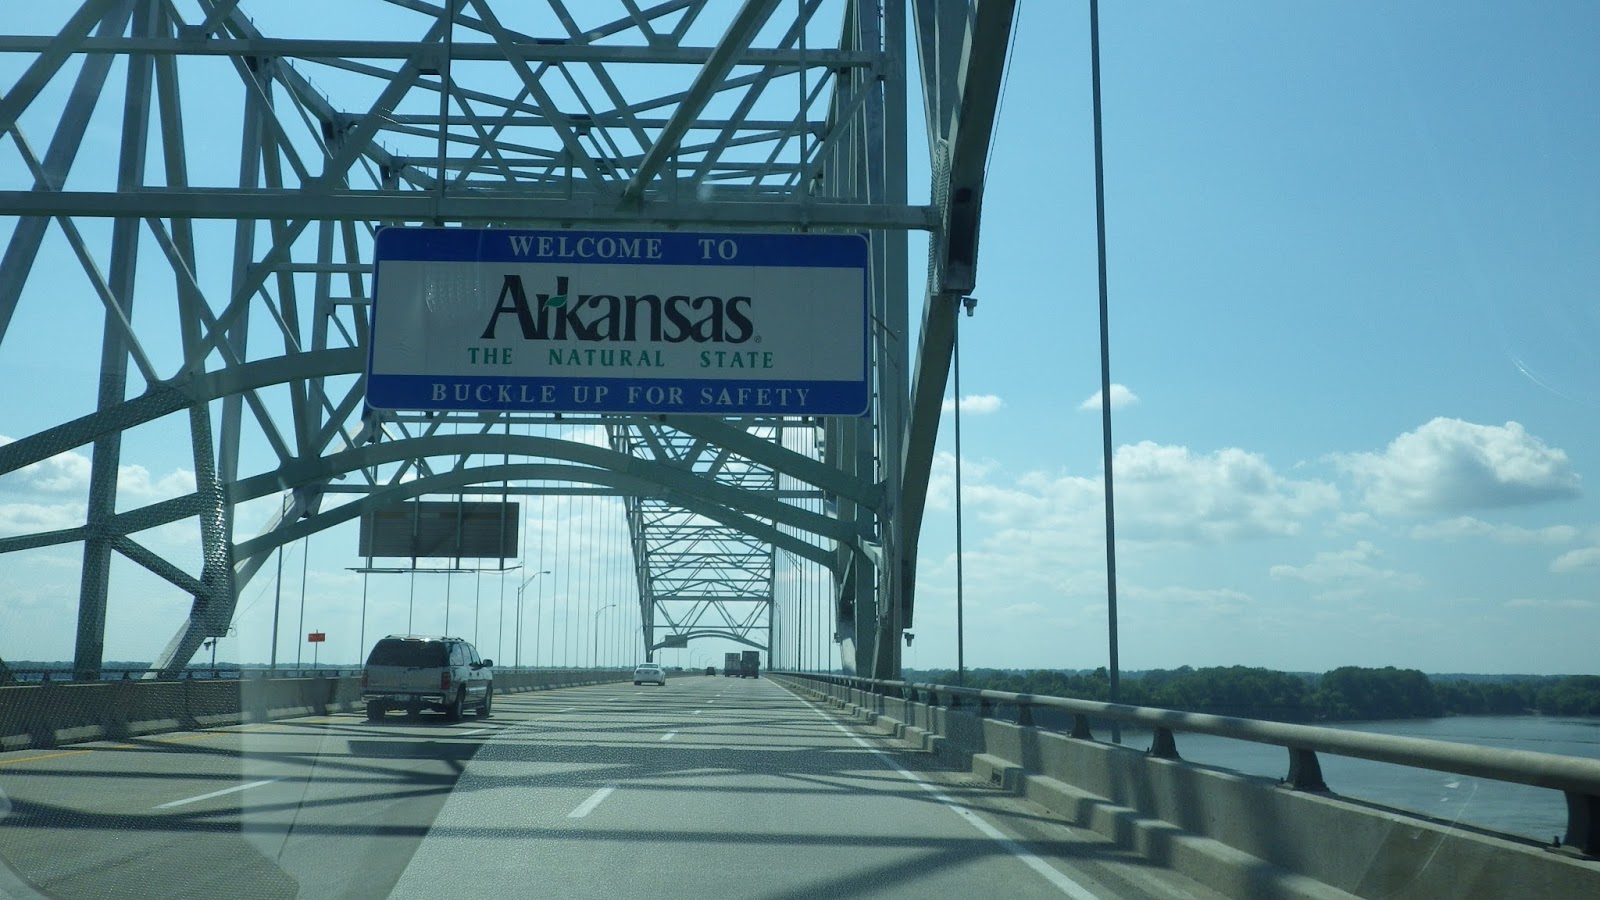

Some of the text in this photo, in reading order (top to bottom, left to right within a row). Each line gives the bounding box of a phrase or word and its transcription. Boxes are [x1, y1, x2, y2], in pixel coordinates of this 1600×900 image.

[509, 235, 738, 260] WELCOME TO
[467, 347, 774, 369] THE NATURAL STATE
[431, 383, 811, 407] BUCKLE UP FOR SAFETY
